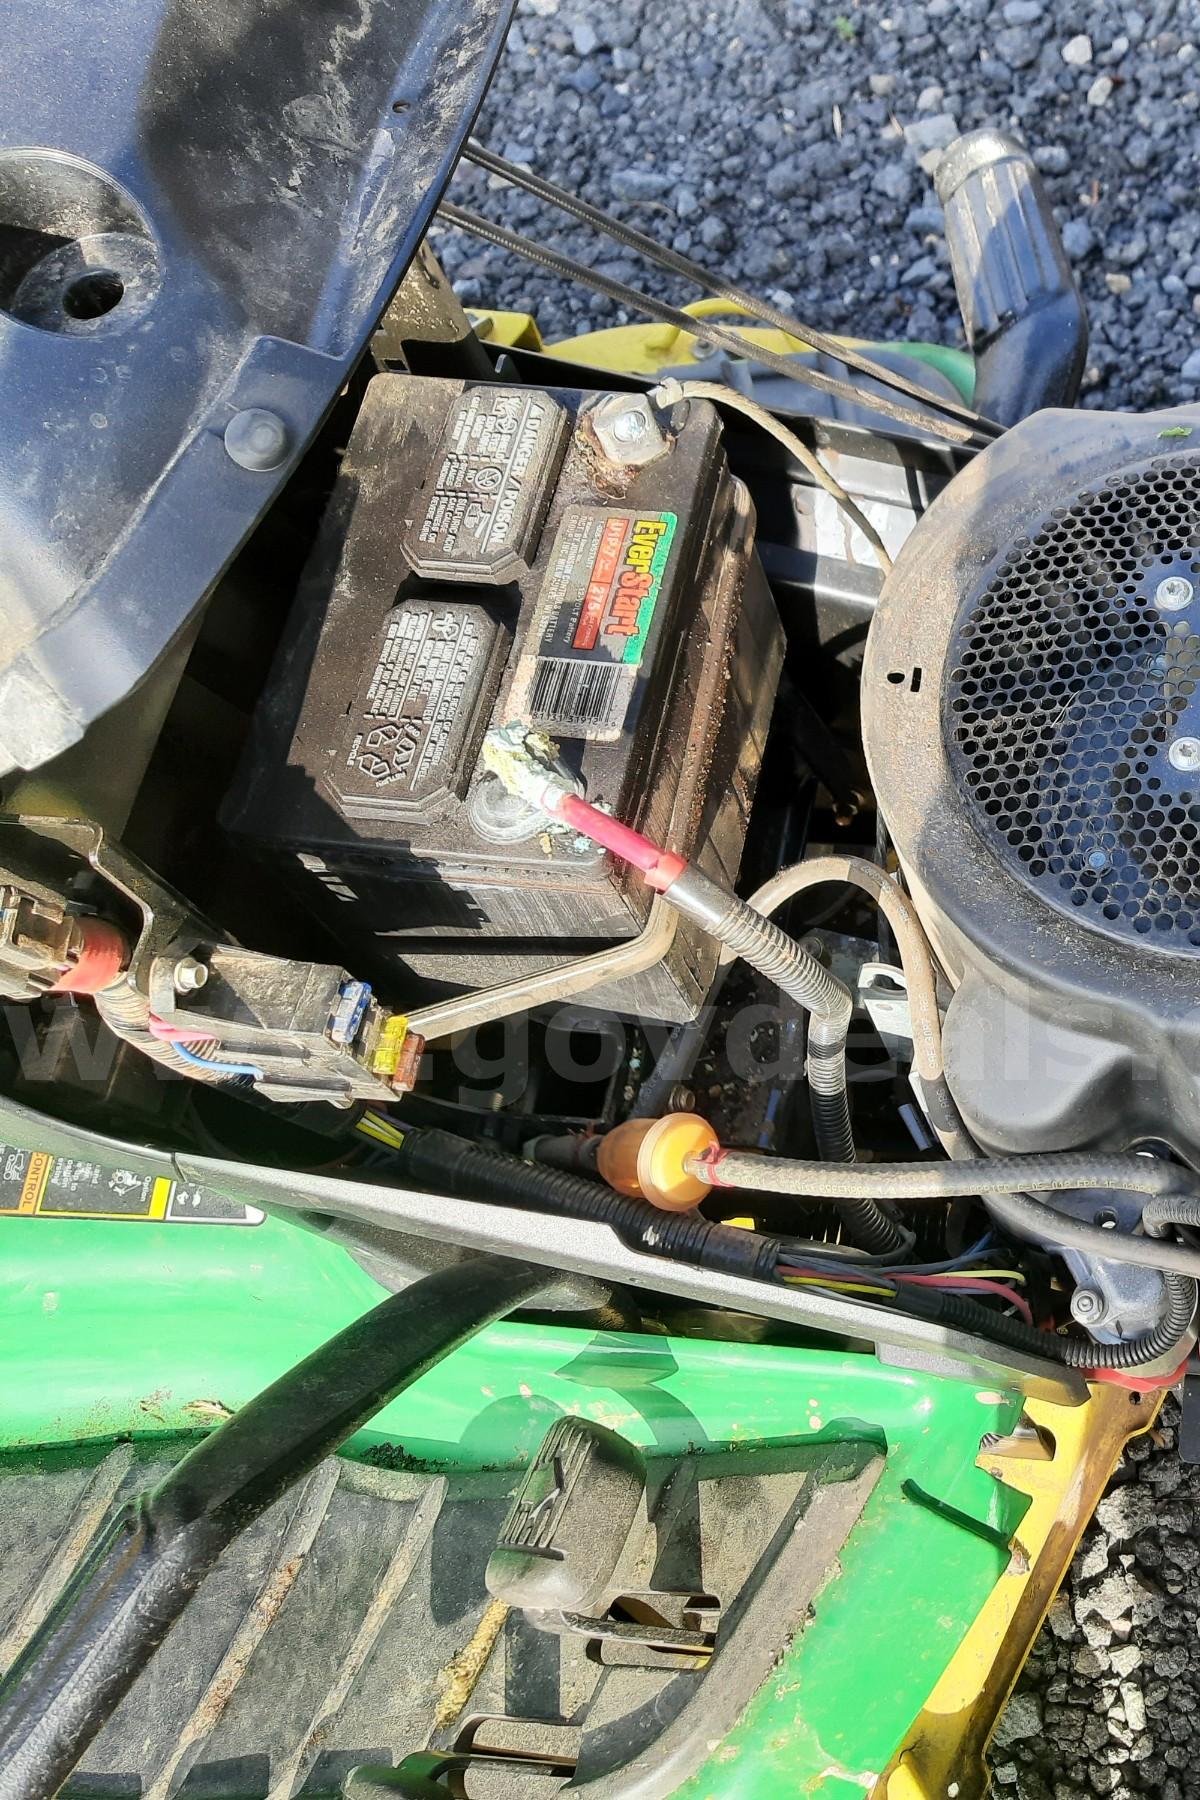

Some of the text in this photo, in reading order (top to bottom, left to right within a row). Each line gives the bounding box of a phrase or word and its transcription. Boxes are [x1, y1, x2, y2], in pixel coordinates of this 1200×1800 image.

[464, 469, 476, 481] NO
[418, 496, 438, 540] SEVERE BURNS
[427, 497, 448, 542] BLINDNESS OR
[439, 498, 456, 532] CAN CAUSE
[442, 498, 467, 551] SULFURIC ACID
[604, 520, 668, 635] EverStart
[553, 575, 570, 609] CONTROLS
[586, 587, 605, 609] 275
[562, 587, 585, 642] 12-VOLT Battery
[544, 611, 559, 641] BATTERY
[460, 656, 471, 669] OUT
[381, 670, 391, 682] NOT
[412, 667, 426, 683] HELP
[419, 682, 432, 694] GET
[452, 683, 463, 696] THE
[436, 701, 449, 719] CAPS
[445, 698, 459, 719] REACH
[429, 721, 442, 740] TIGHT
[441, 721, 451, 730] OF
[346, 734, 362, 765] RECYCLE
[424, 743, 436, 757] AND
